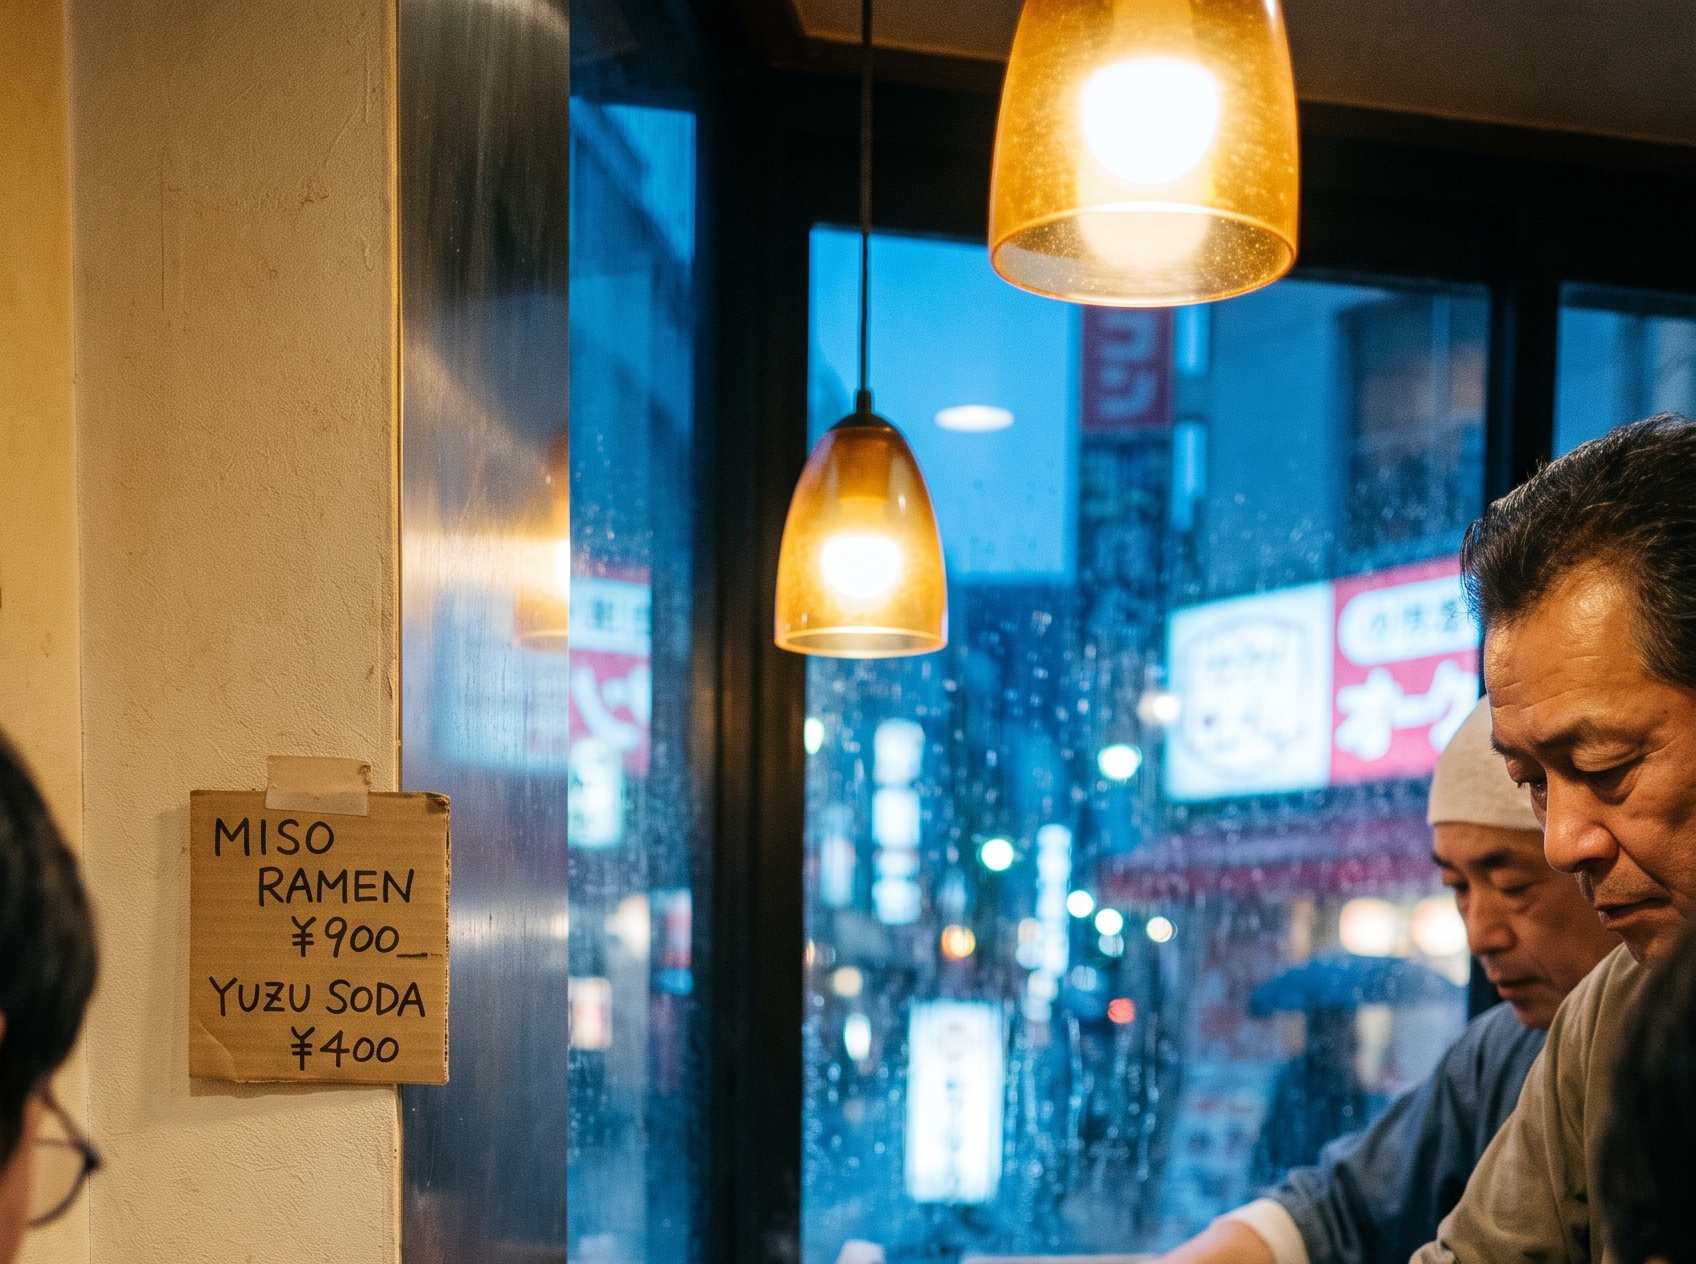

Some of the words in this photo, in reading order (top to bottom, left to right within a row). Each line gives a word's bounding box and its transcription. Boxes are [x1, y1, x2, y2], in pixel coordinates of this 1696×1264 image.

[214, 817, 335, 857] MISO
[258, 866, 415, 907] RAMEN
[208, 976, 311, 1017] YUZU
[325, 979, 426, 1018] SODA
[290, 1026, 400, 1071] ¥400
